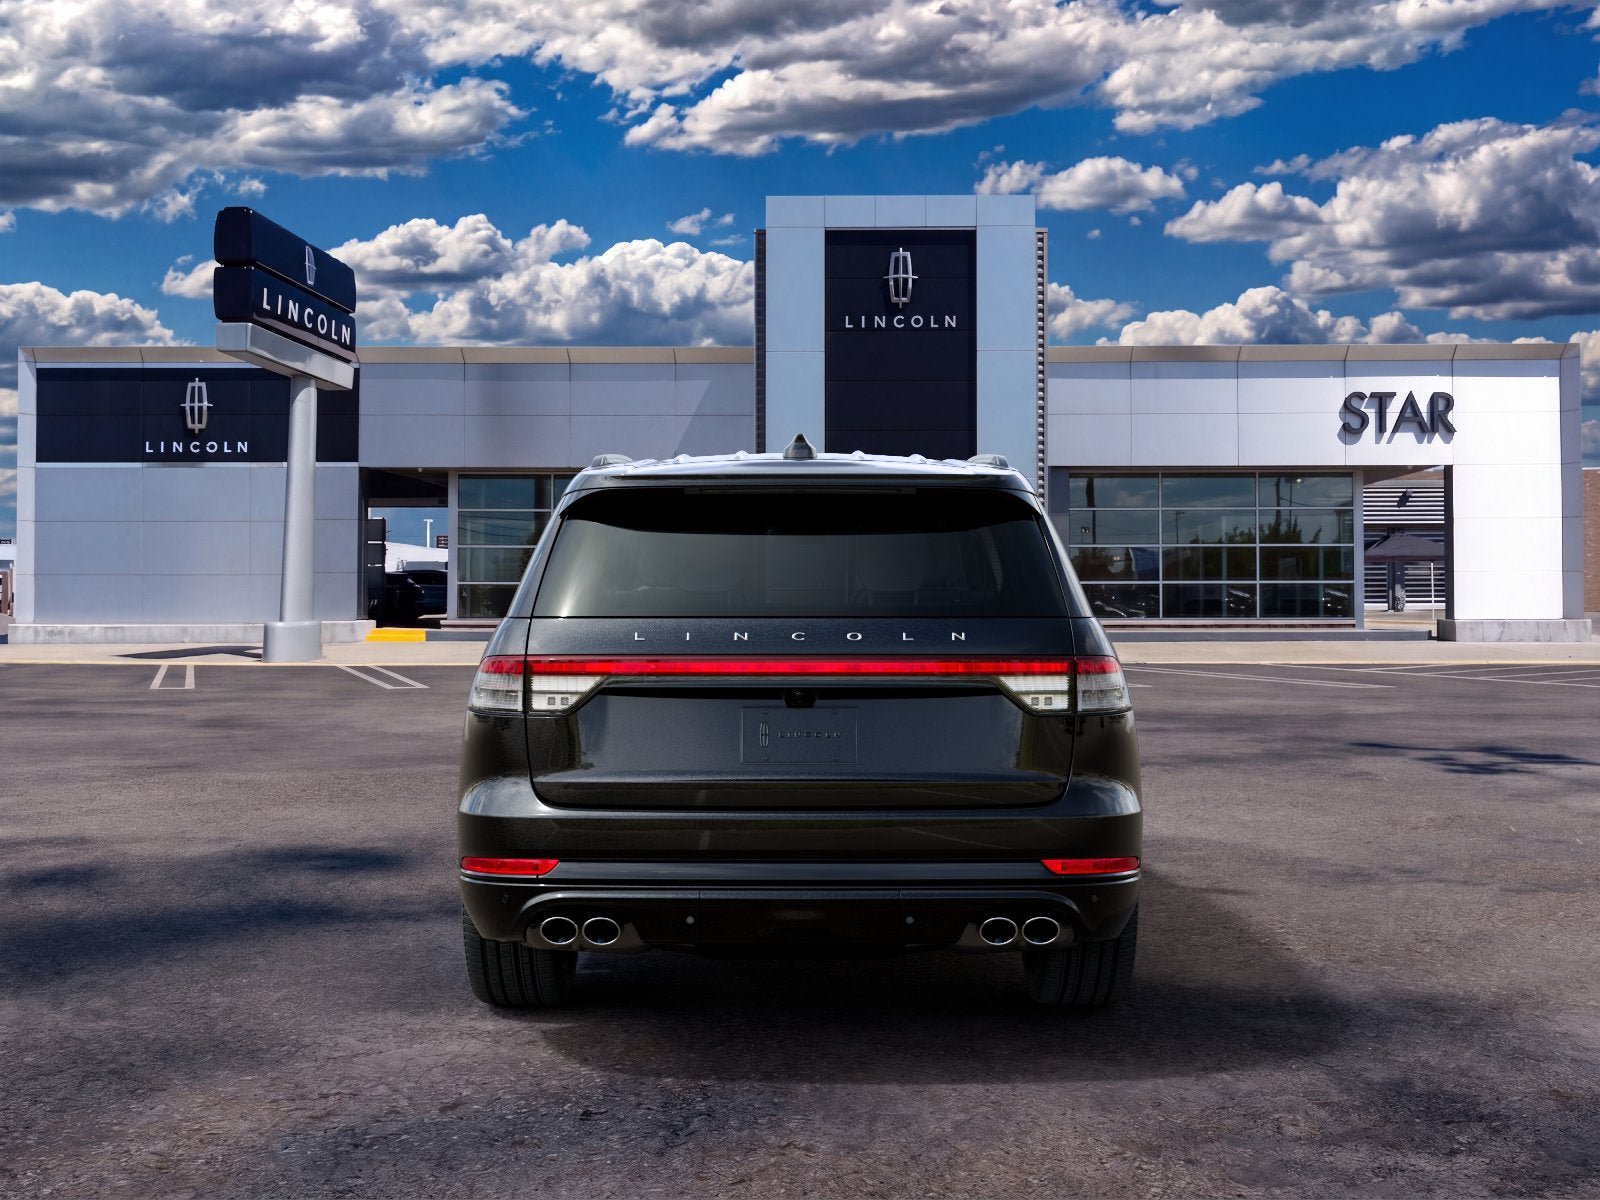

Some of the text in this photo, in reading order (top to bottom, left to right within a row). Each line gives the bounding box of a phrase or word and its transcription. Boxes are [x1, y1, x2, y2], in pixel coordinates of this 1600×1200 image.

[262, 287, 351, 345] LINCOLN
[846, 315, 956, 328] LINCOLN
[1342, 391, 1457, 435] STAR
[145, 441, 248, 453] LINCOLN
[634, 631, 966, 641] LINCOLN
